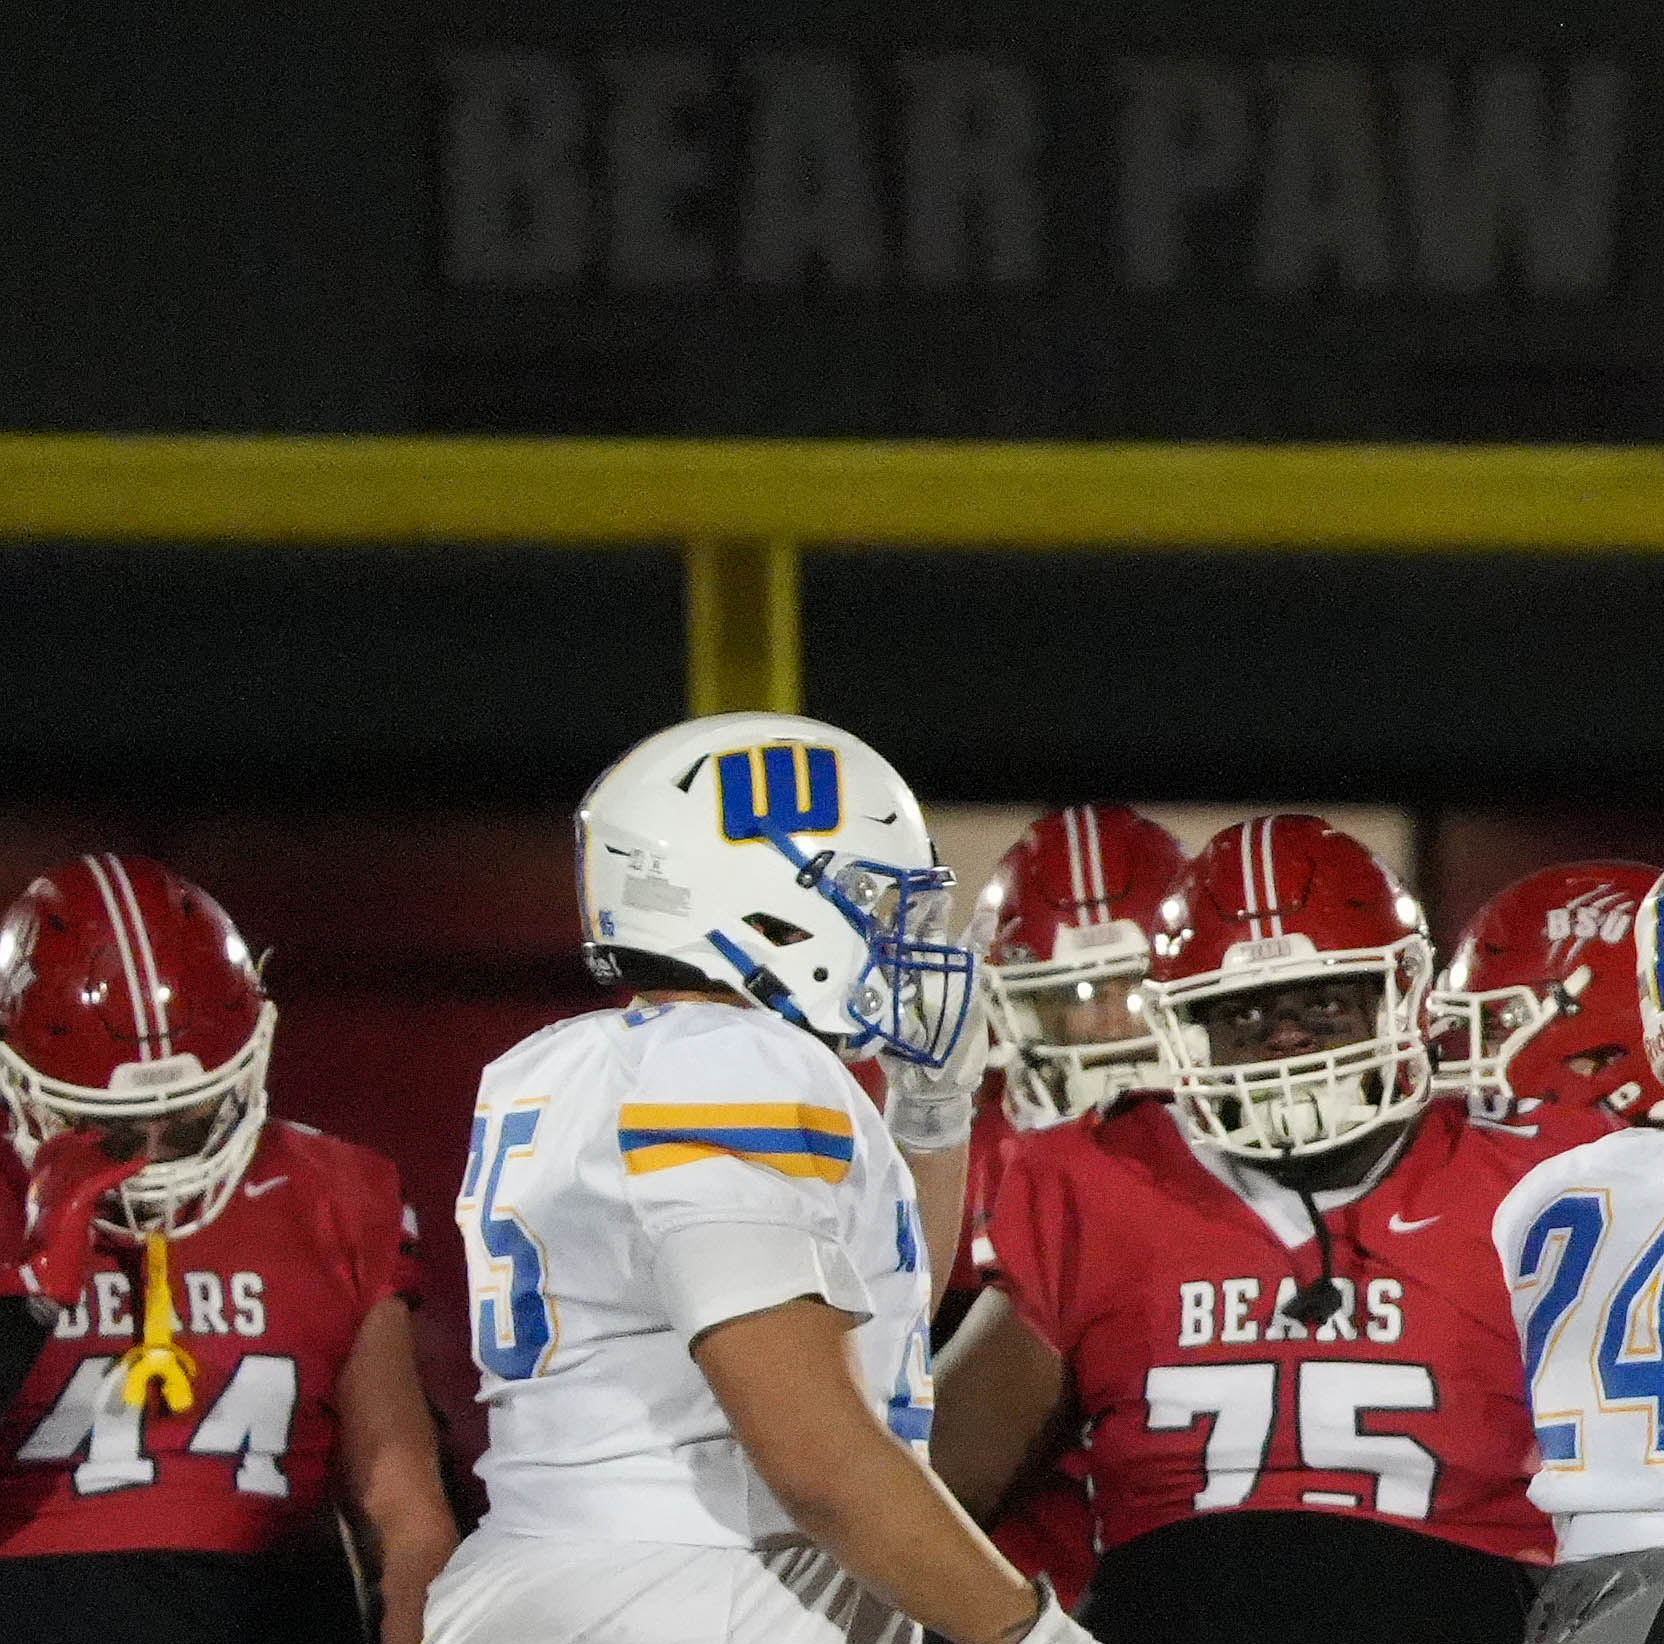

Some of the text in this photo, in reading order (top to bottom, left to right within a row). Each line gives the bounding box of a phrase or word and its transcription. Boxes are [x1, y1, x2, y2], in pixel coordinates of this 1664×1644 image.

[440, 54, 1629, 296] BEAR PAW
[1544, 905, 1632, 944] BSU
[53, 1272, 266, 1339] ERS
[1178, 1276, 1404, 1348] BEARS
[15, 1353, 298, 1499] 44
[1140, 1358, 1443, 1522] 75
